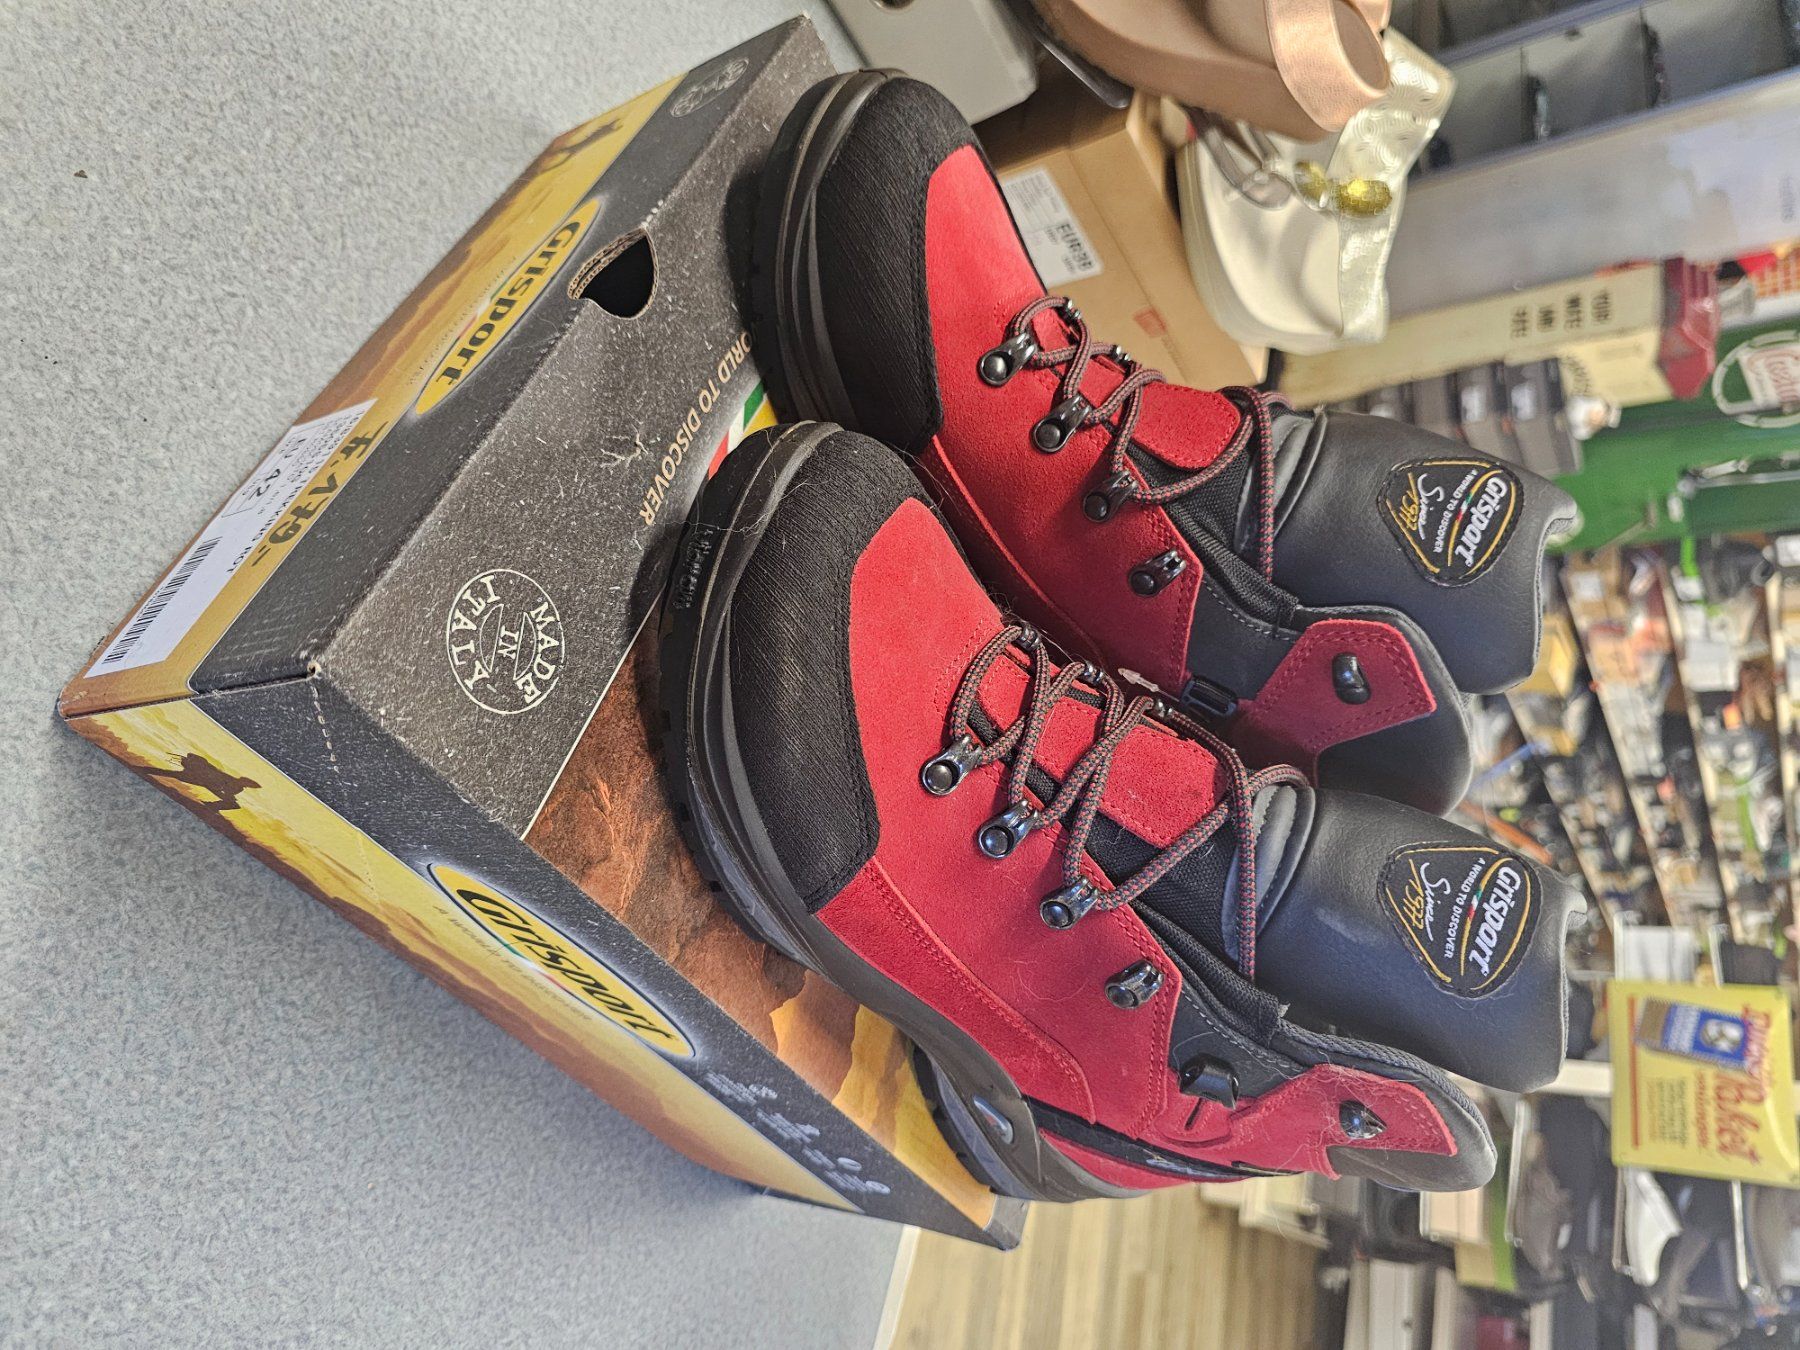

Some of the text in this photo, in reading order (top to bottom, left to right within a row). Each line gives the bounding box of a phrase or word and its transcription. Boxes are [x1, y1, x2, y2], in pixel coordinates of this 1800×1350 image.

[436, 222, 580, 386] Grisport
[639, 331, 752, 525] ORLD TO DISCOVER
[250, 468, 281, 500] 42
[1447, 498, 1458, 511] TO
[1453, 473, 1475, 499] WORLD
[1433, 511, 1452, 553] DISCOVER
[1455, 477, 1508, 565] Grisport
[451, 575, 501, 690] ITALY
[498, 626, 519, 659] IN
[515, 602, 559, 703] MADE
[1420, 862, 1451, 942] Since
[1456, 892, 1467, 904] TO
[1461, 864, 1483, 892] WORLD
[1444, 905, 1462, 959] DISCOVER
[1469, 866, 1521, 974] Grisport
[456, 889, 672, 1039] Grisport
